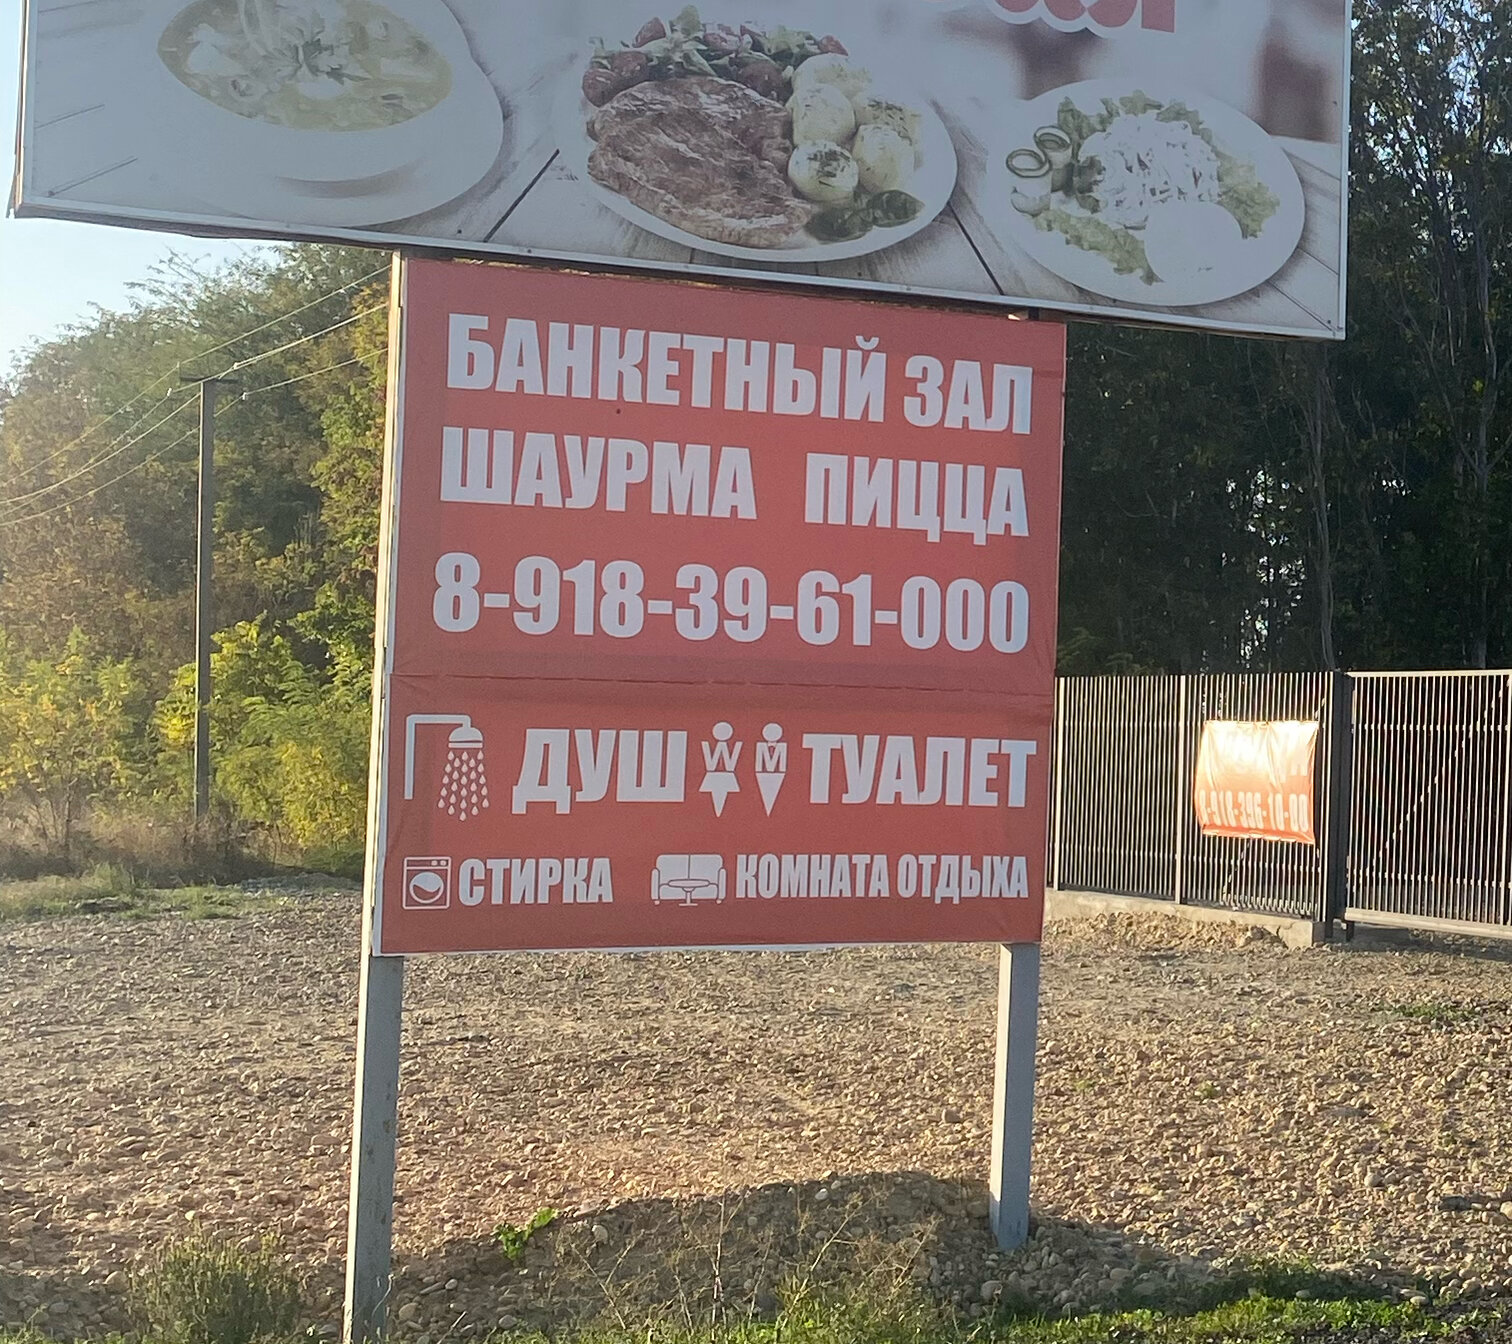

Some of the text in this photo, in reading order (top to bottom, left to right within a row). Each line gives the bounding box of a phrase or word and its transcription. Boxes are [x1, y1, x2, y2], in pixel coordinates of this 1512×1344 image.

[447, 312, 1033, 434] БАНКЕТНЫЙ ЗАЛ
[440, 426, 1029, 544] ШАУРМА ПИЦЦА
[433, 552, 1030, 653] 8-918-39-61-000
[512, 728, 688, 814] ДУШ
[802, 733, 1037, 808] ТУАЛЕТ
[458, 854, 1030, 906] СТИРКА КОМНАТА ОТДЫХА
